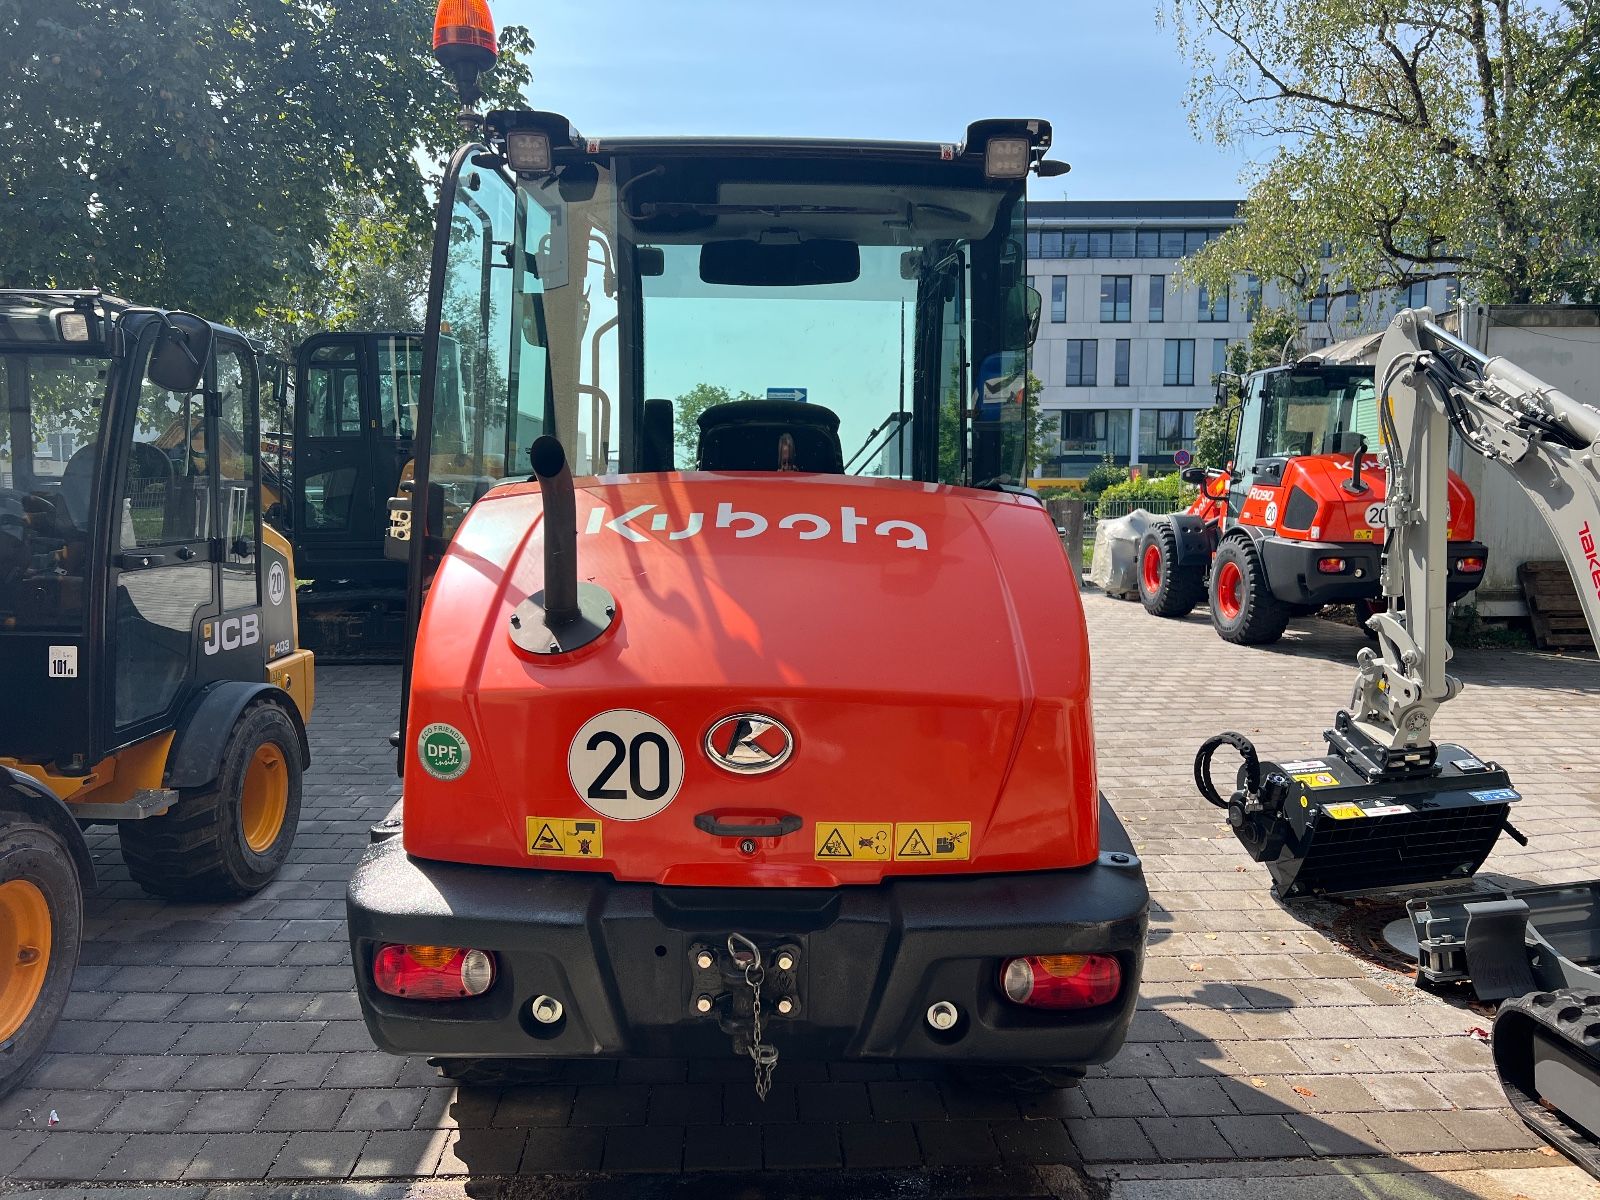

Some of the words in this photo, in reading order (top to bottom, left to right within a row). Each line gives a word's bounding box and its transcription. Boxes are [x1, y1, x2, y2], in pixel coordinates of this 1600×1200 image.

[1249, 487, 1275, 501] R090
[1266, 506, 1276, 522] 20
[585, 503, 929, 550] Kubota
[271, 572, 281, 595] 20
[204, 613, 260, 656] JCB
[275, 640, 290, 654] 403
[53, 659, 67, 675] 101
[421, 727, 433, 741] ECO
[433, 725, 466, 745] FRIENDLY
[428, 744, 458, 759] DPF
[435, 756, 459, 766] inside
[586, 730, 670, 801] 20
